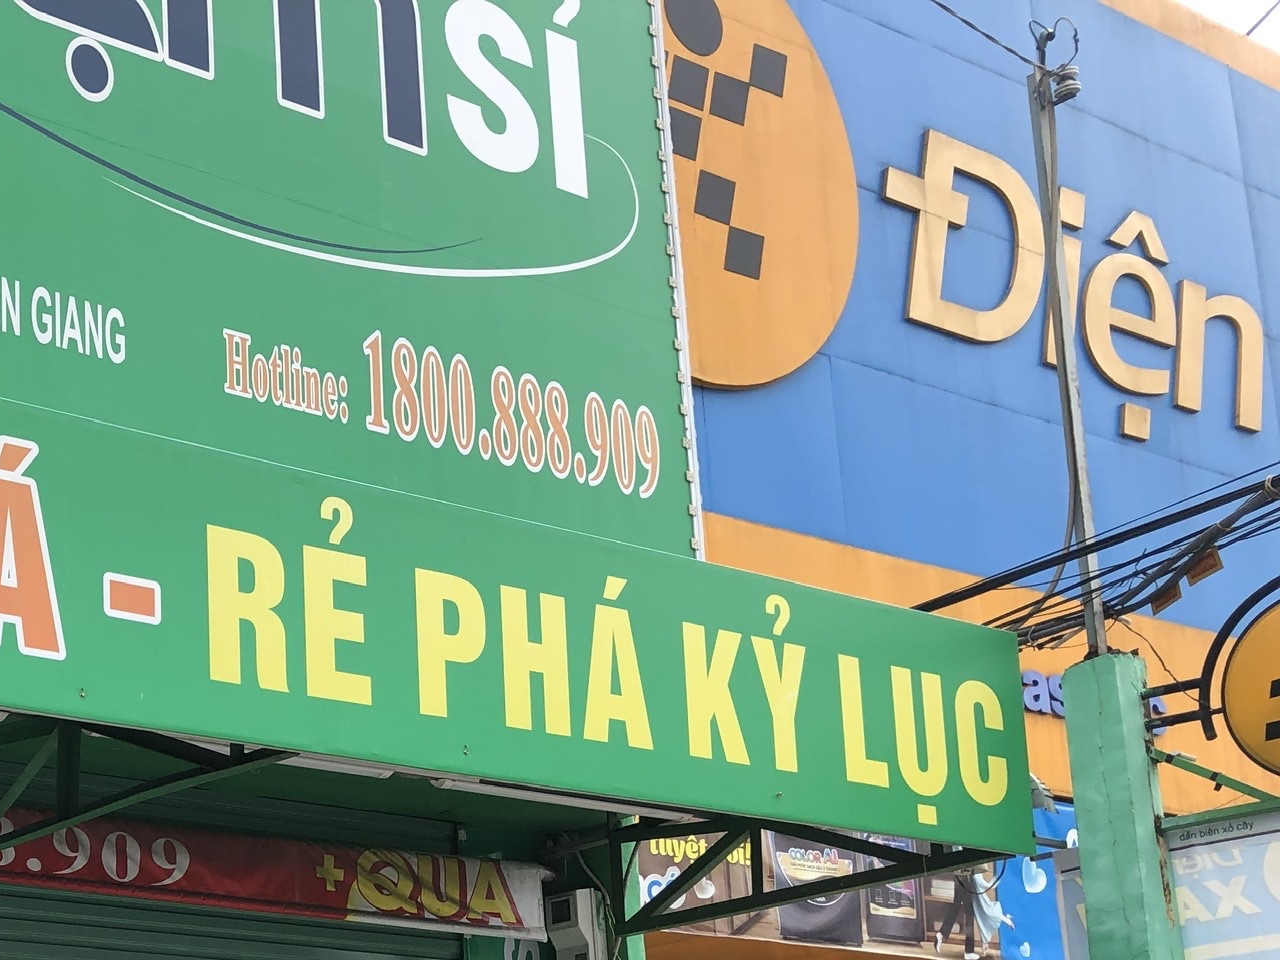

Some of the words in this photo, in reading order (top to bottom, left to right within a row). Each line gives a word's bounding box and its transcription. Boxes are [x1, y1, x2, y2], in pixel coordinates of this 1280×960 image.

[30, 286, 126, 365] GIANG
[882, 128, 1265, 442] Điện
[223, 328, 348, 424] Hotline:
[362, 329, 661, 500] 1800.888.909
[207, 496, 372, 705] RẺ
[415, 575, 654, 750] PHÁ
[683, 594, 806, 772] KỶ
[838, 654, 1009, 826] LỤC
